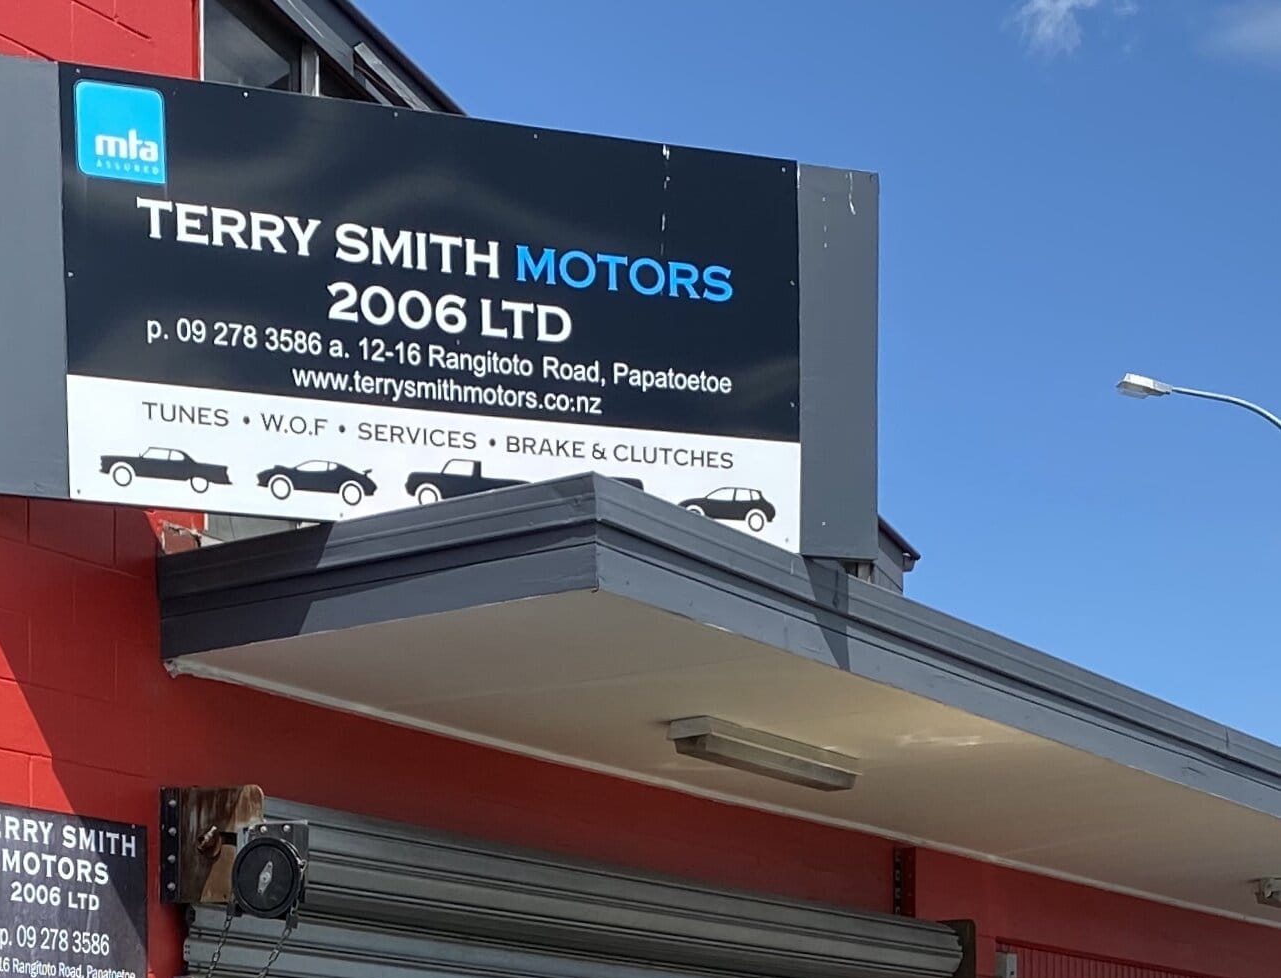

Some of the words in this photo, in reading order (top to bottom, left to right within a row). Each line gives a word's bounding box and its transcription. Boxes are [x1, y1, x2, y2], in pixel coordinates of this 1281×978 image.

[95, 128, 159, 163] mta
[136, 196, 321, 256] TERRY
[335, 222, 500, 279] SMITH
[516, 245, 733, 302] MOTORS
[327, 282, 467, 334] 2006
[480, 298, 572, 343] LTD
[147, 319, 169, 343] p.
[177, 317, 206, 343] 09
[213, 322, 258, 349] 278
[265, 327, 321, 355] 3586
[329, 338, 350, 359] a.
[359, 337, 421, 365] 12-16
[429, 344, 533, 378] Rangitoto
[543, 356, 606, 387] Road,
[613, 362, 732, 393] Papatoetoe
[292, 368, 602, 415] www.terrysmithmotors.co.nz
[142, 401, 229, 427] TUNES
[261, 413, 329, 437] W.O.F
[357, 422, 477, 449] SERVICES
[506, 435, 585, 459] BRAKE
[591, 443, 607, 460] &
[613, 444, 734, 470] CLUTCHES
[62, 825, 136, 858] SMITH
[2, 849, 109, 885] MOTORS
[10, 881, 61, 906] 2006
[68, 891, 100, 911] LTD
[0, 928, 12, 949] p.
[16, 925, 36, 948] 09
[40, 927, 68, 951] 278
[72, 931, 109, 956] 3586
[13, 958, 56, 978] Rangitoto
